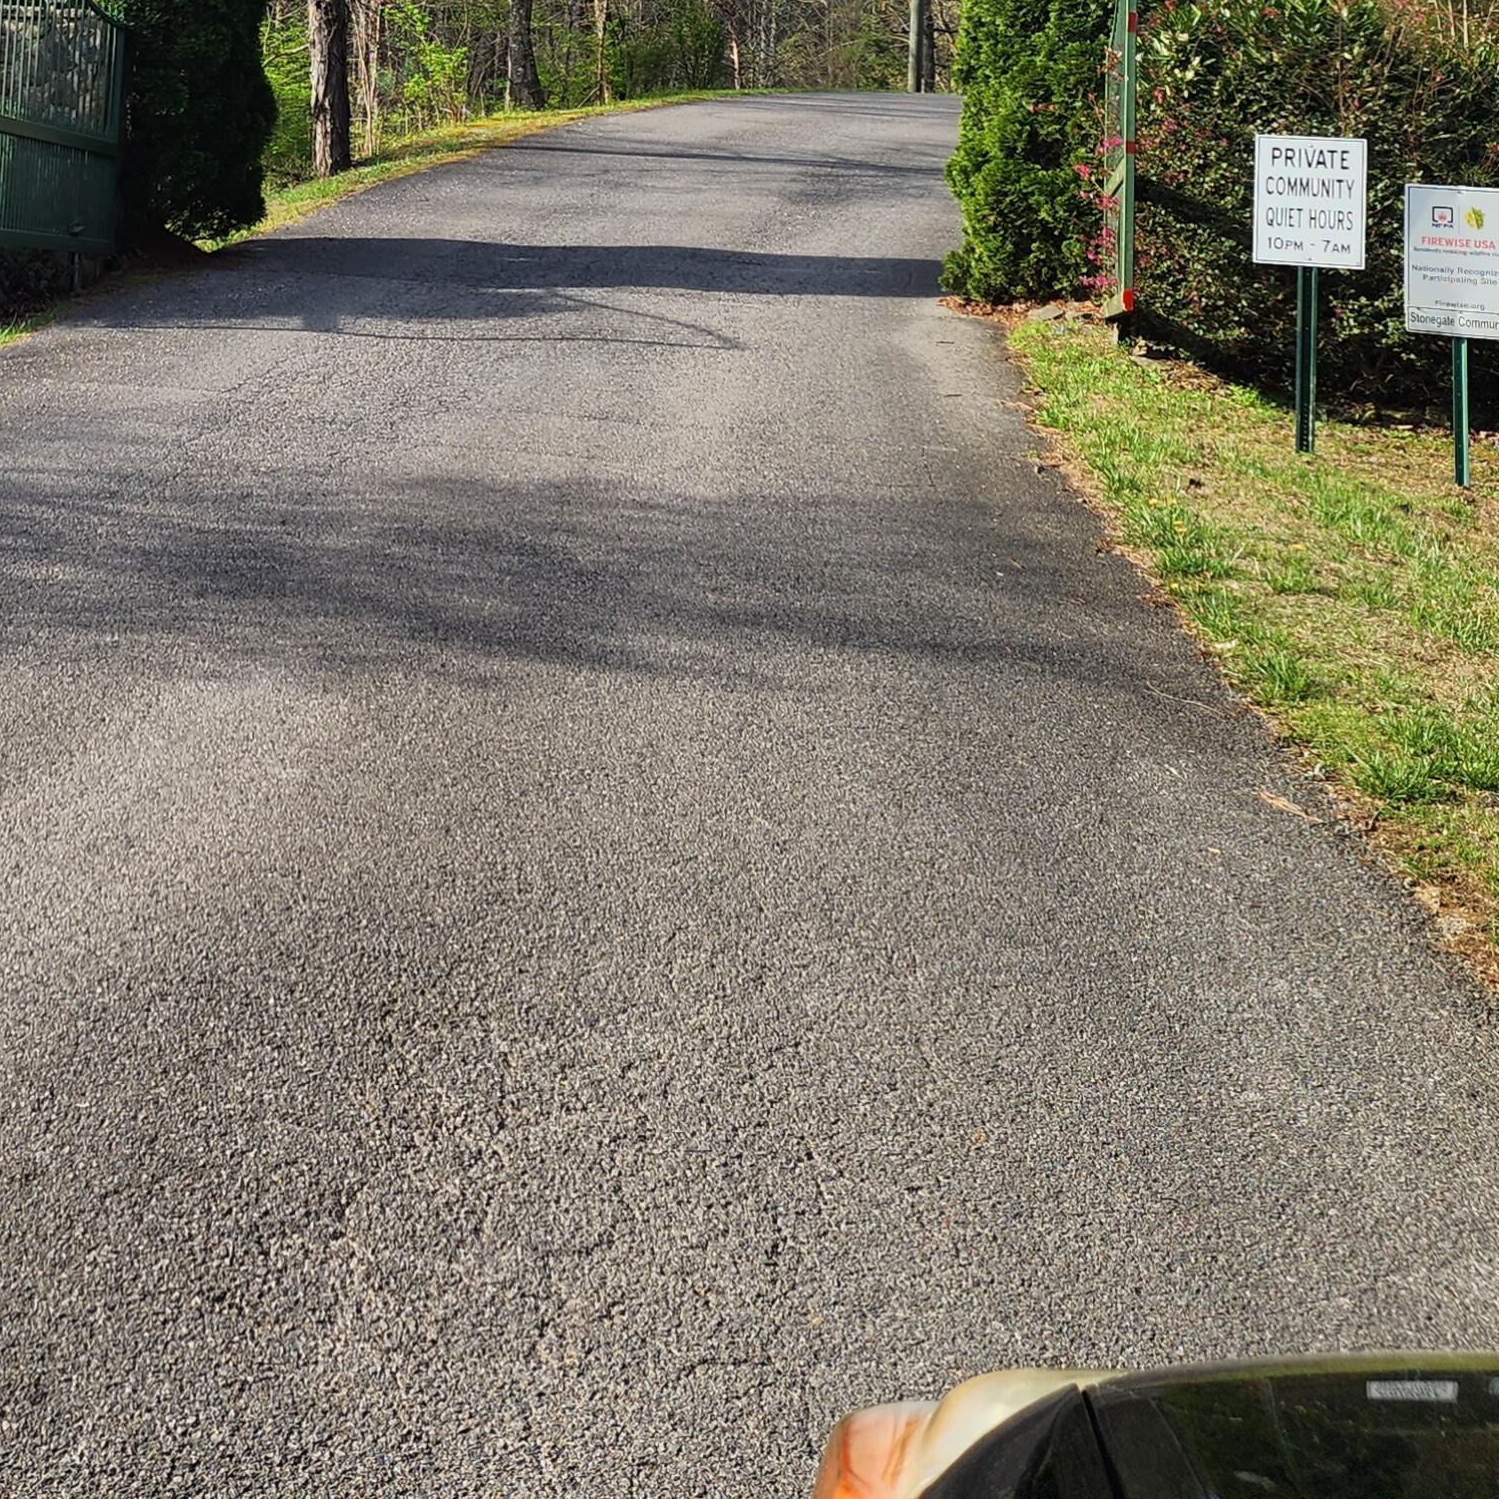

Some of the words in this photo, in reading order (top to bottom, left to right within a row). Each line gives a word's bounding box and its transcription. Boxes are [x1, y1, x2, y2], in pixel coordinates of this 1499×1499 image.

[1271, 147, 1350, 170] PRIVATE
[1265, 176, 1355, 199] COMMUNITY
[1266, 207, 1303, 228] QUIET
[1309, 208, 1353, 231] HOURS
[1267, 236, 1304, 251] 10PM
[1322, 240, 1351, 253] 7AM
[1421, 236, 1471, 248] FIREWISE
[1474, 240, 1496, 249] USA
[1411, 264, 1455, 276] Nationally
[1422, 273, 1478, 286] Participating
[1480, 277, 1498, 286] Site
[1435, 300, 1485, 311] Firewise.org
[1410, 311, 1455, 328] Stonegate
